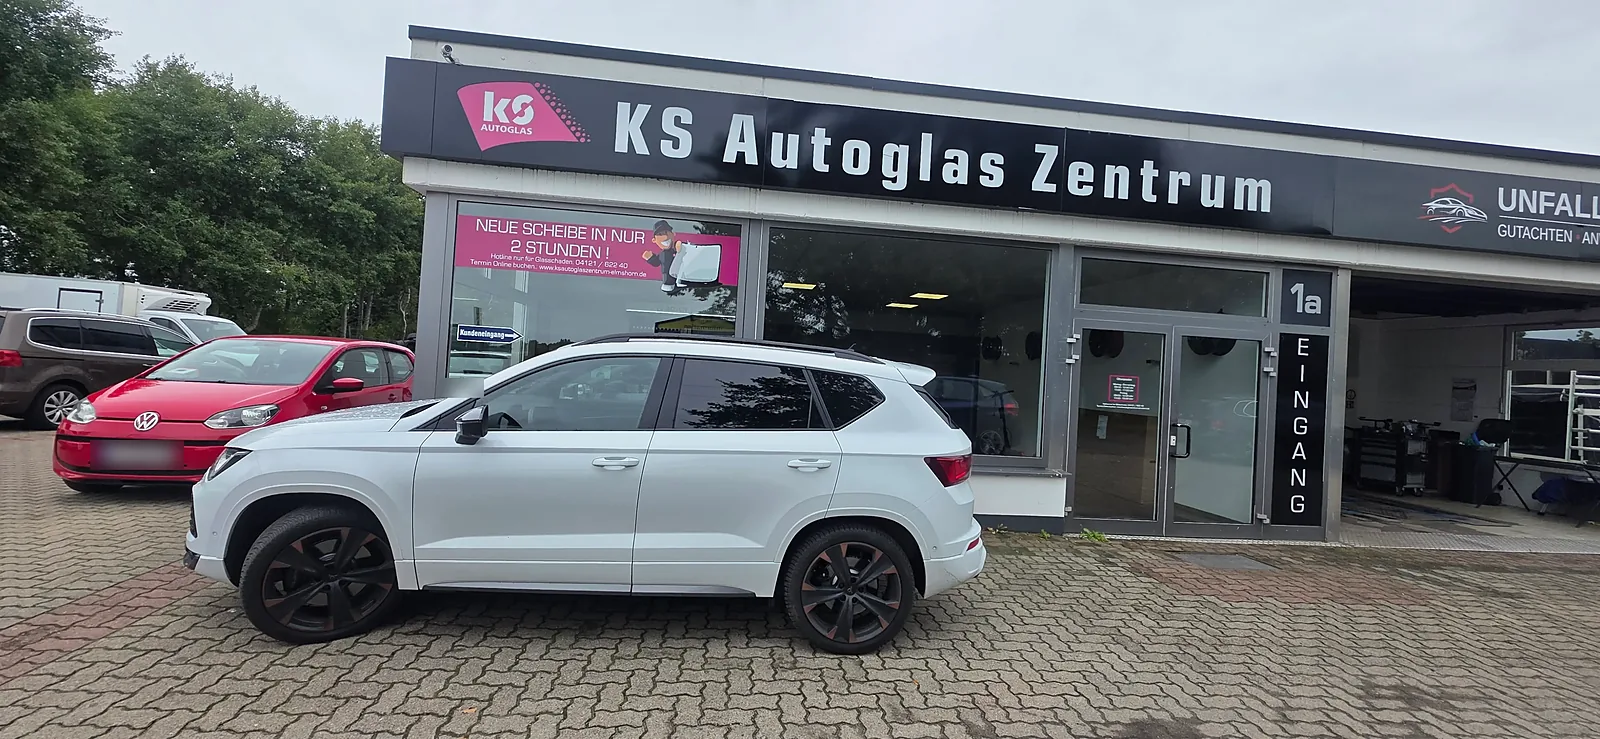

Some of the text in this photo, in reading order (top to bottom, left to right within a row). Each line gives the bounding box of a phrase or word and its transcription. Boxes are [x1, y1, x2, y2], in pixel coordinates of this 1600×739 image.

[480, 123, 533, 135] AUTOGLAS
[614, 101, 1272, 213] KS Autoglas Zentrum
[476, 218, 646, 245] NEUE SCHEIBE IN NUR
[1497, 223, 1573, 243] GUTACHTEN
[490, 253, 513, 261] Hotline
[575, 259, 597, 267] 04121
[510, 240, 610, 260] 2 STUNDEN !
[470, 258, 492, 266] Termin
[492, 260, 512, 268] Online
[1290, 283, 1322, 315] 1a
[459, 328, 505, 339] Kundeneingang
[133, 411, 159, 431] VW
[1290, 337, 1310, 514] EINGANG
